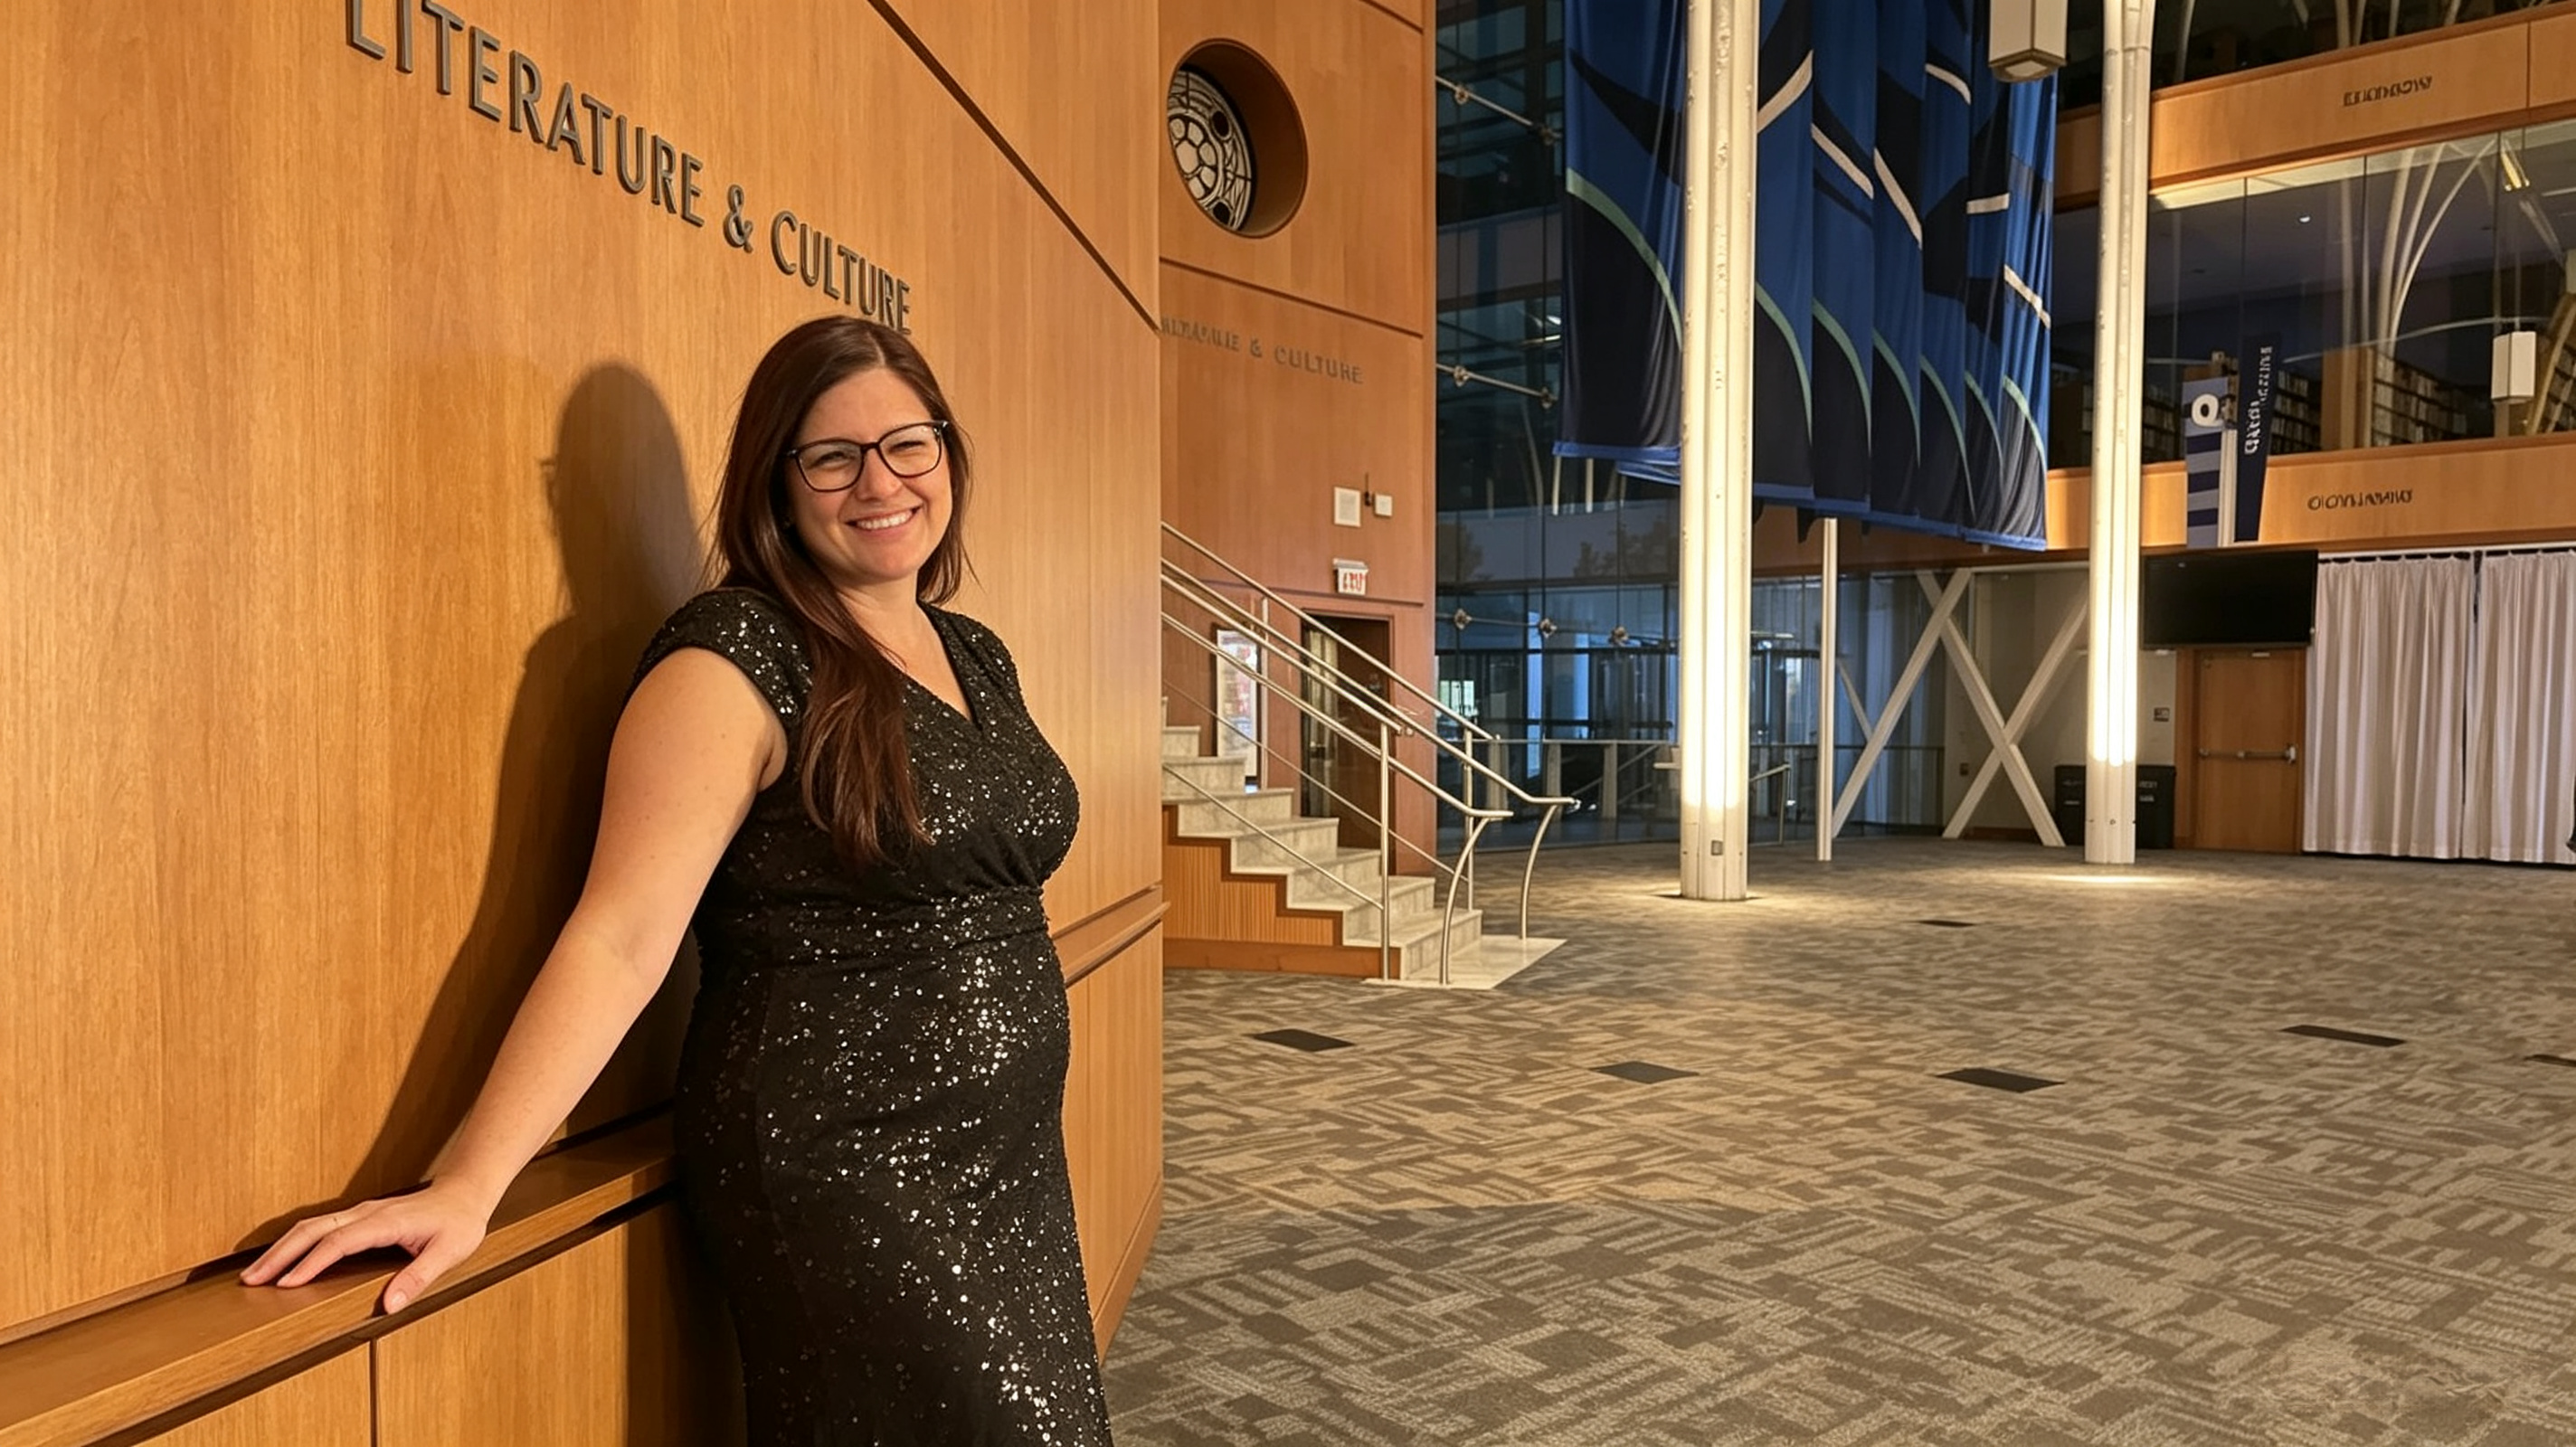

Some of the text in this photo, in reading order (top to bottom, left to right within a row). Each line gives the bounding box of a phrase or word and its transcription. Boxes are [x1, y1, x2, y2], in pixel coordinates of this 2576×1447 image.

[346, 0, 911, 335] LITERATURE & CULTURE
[1274, 345, 1363, 383] CULTURE
